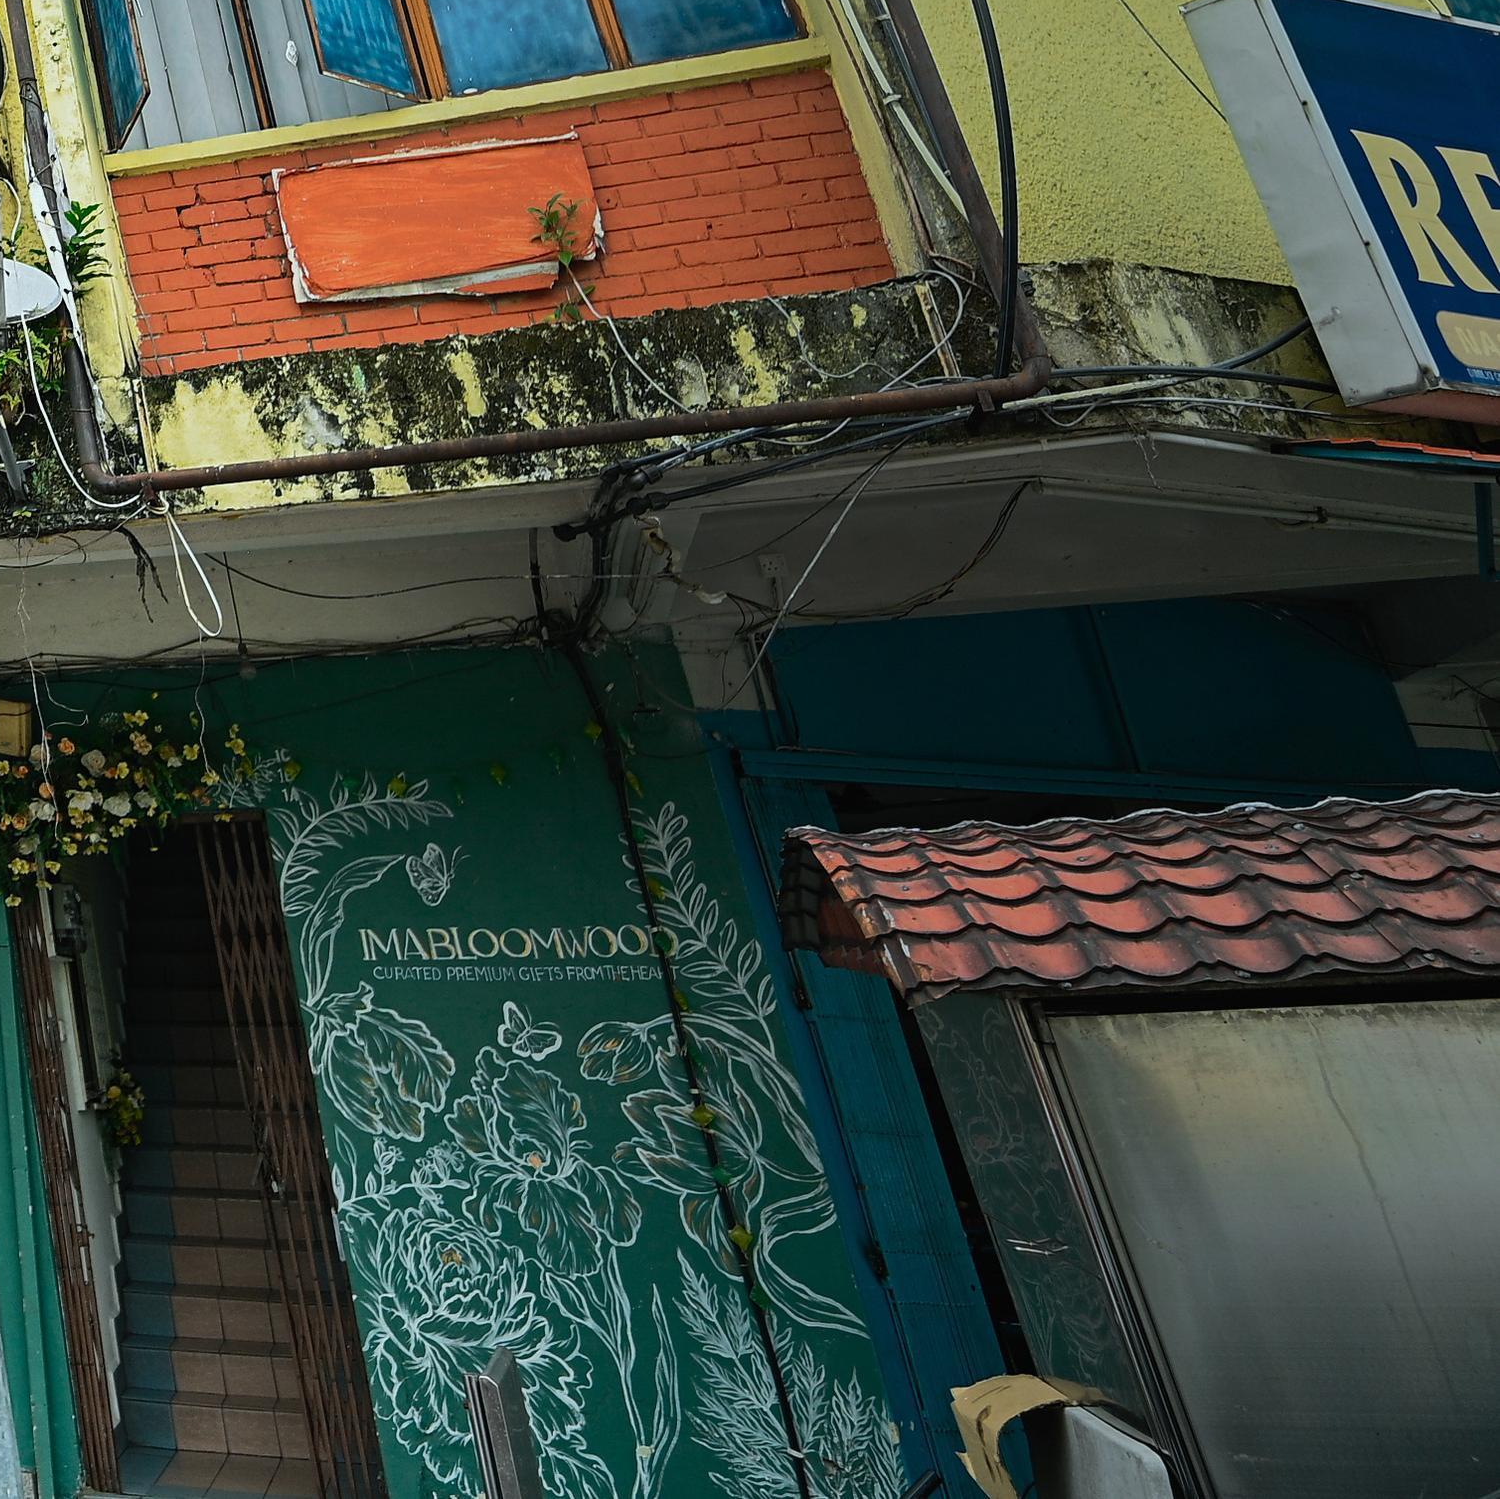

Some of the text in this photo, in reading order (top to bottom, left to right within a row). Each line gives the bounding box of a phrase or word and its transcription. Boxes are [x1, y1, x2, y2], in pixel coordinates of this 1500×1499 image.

[373, 965, 442, 982] CURATED
[446, 965, 517, 982] PREMIUM
[518, 965, 564, 982] GIFTS
